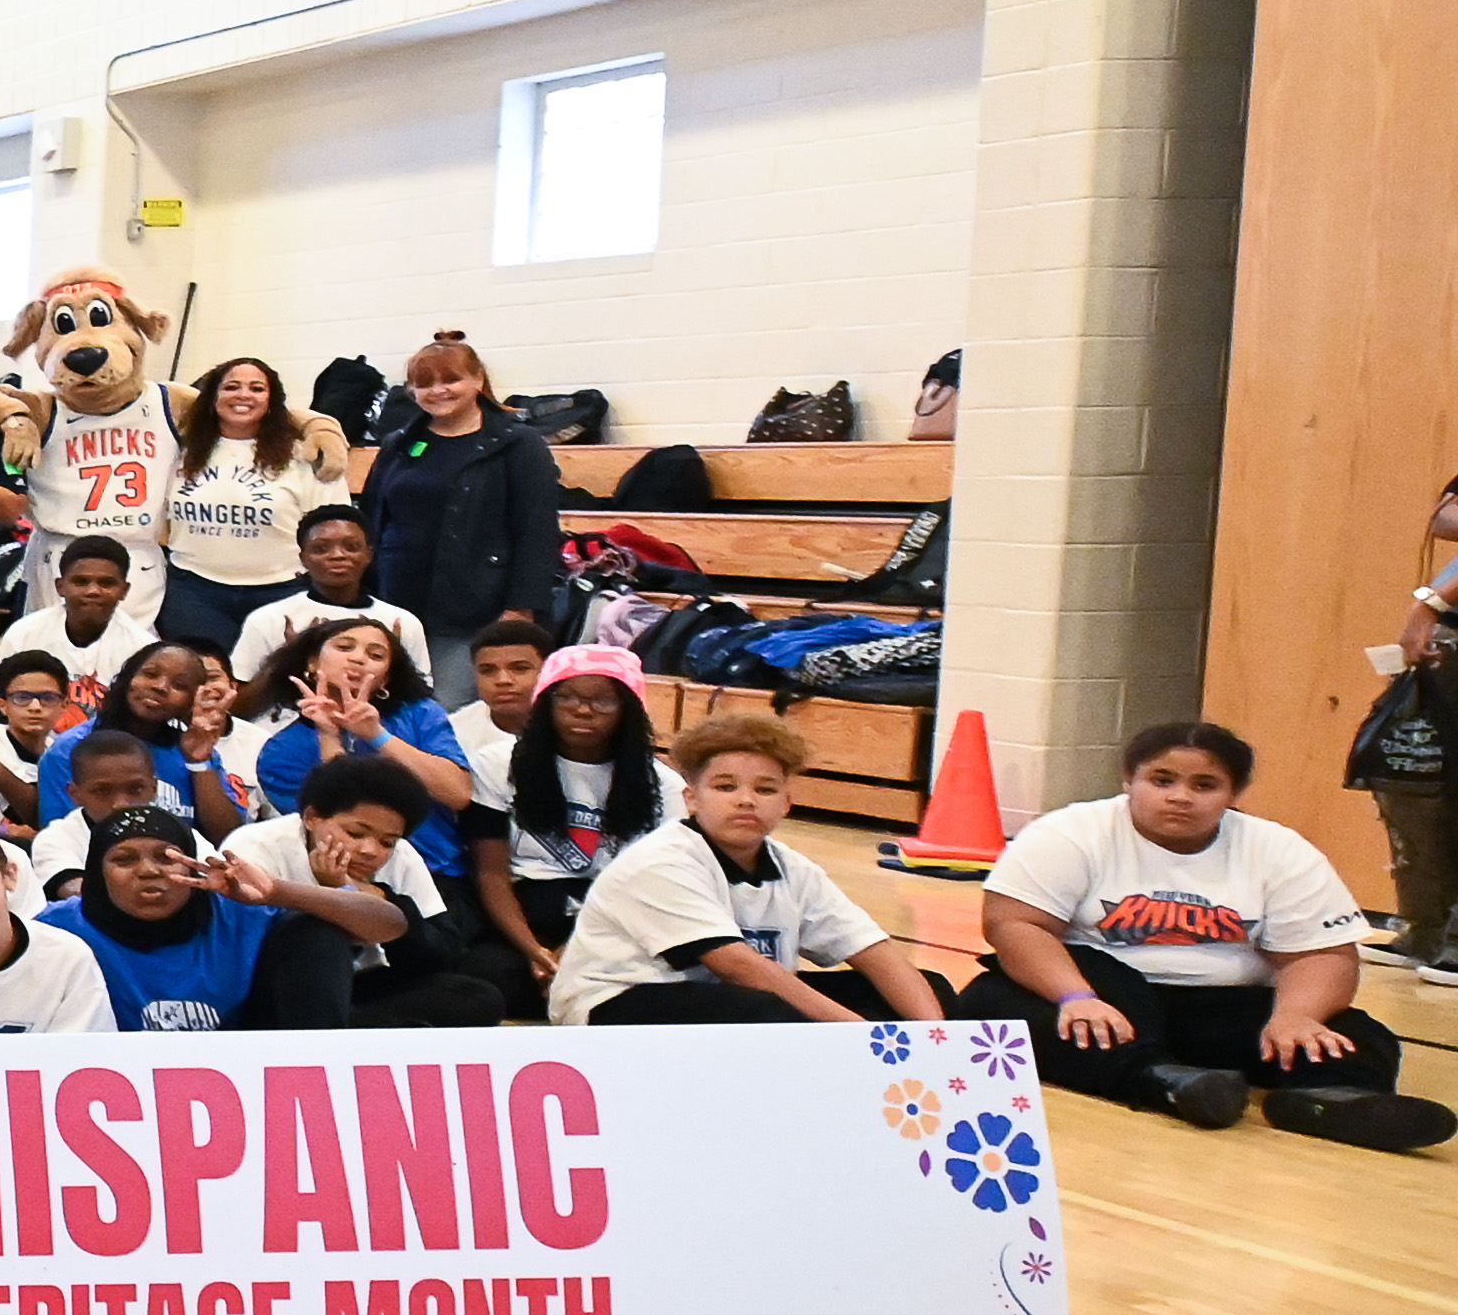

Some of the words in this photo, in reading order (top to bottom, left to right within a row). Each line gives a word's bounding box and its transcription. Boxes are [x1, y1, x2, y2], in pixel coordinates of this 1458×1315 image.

[66, 429, 157, 466] KNICKS
[79, 462, 148, 512] 73
[177, 466, 219, 497] NEW
[231, 465, 274, 502] YORK
[76, 515, 134, 530] CHASE
[173, 501, 274, 527] RANGERS
[188, 526, 222, 536] SINCE
[1098, 894, 1248, 945] KNICKS
